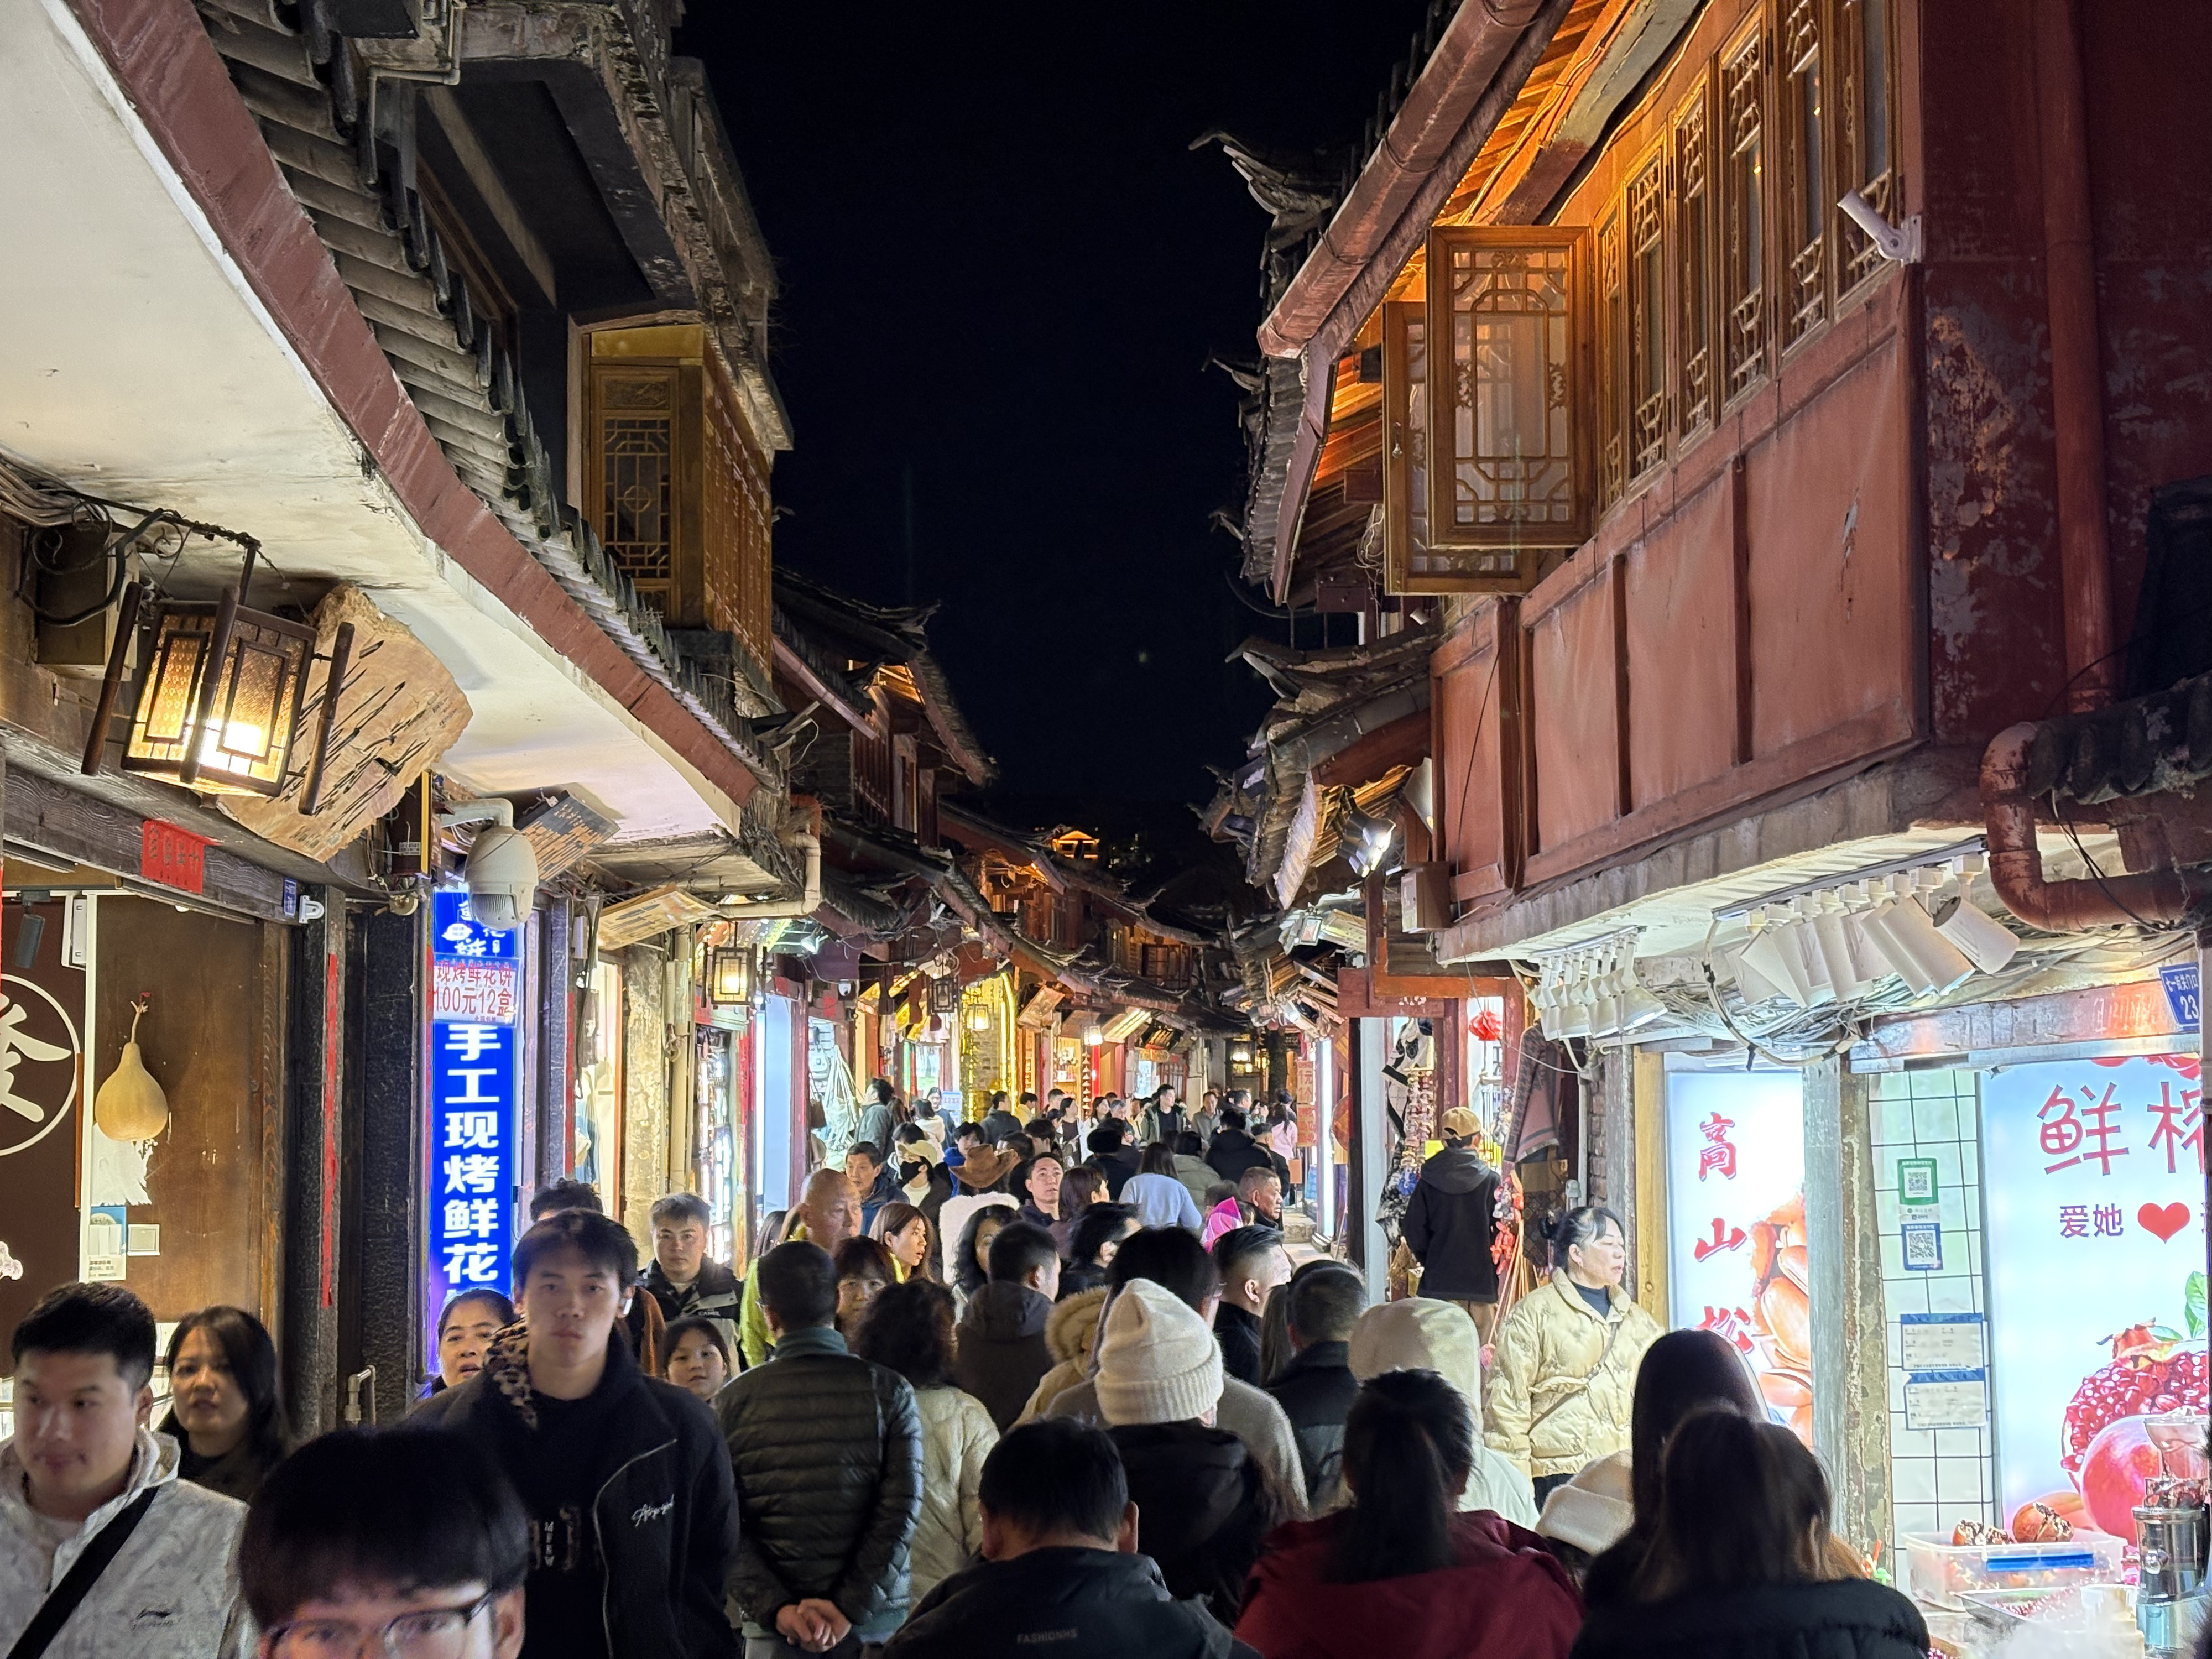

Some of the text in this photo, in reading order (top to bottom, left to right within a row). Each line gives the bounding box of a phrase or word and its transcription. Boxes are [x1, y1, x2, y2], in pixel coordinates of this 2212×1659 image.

[436, 961, 512, 987] 现烤鲜花饼
[434, 986, 512, 1016] 100元12盒
[2180, 994, 2199, 1020] 23
[443, 1024, 502, 1303] 手工现烤鲜花
[2060, 1203, 2124, 1238] 爱她
